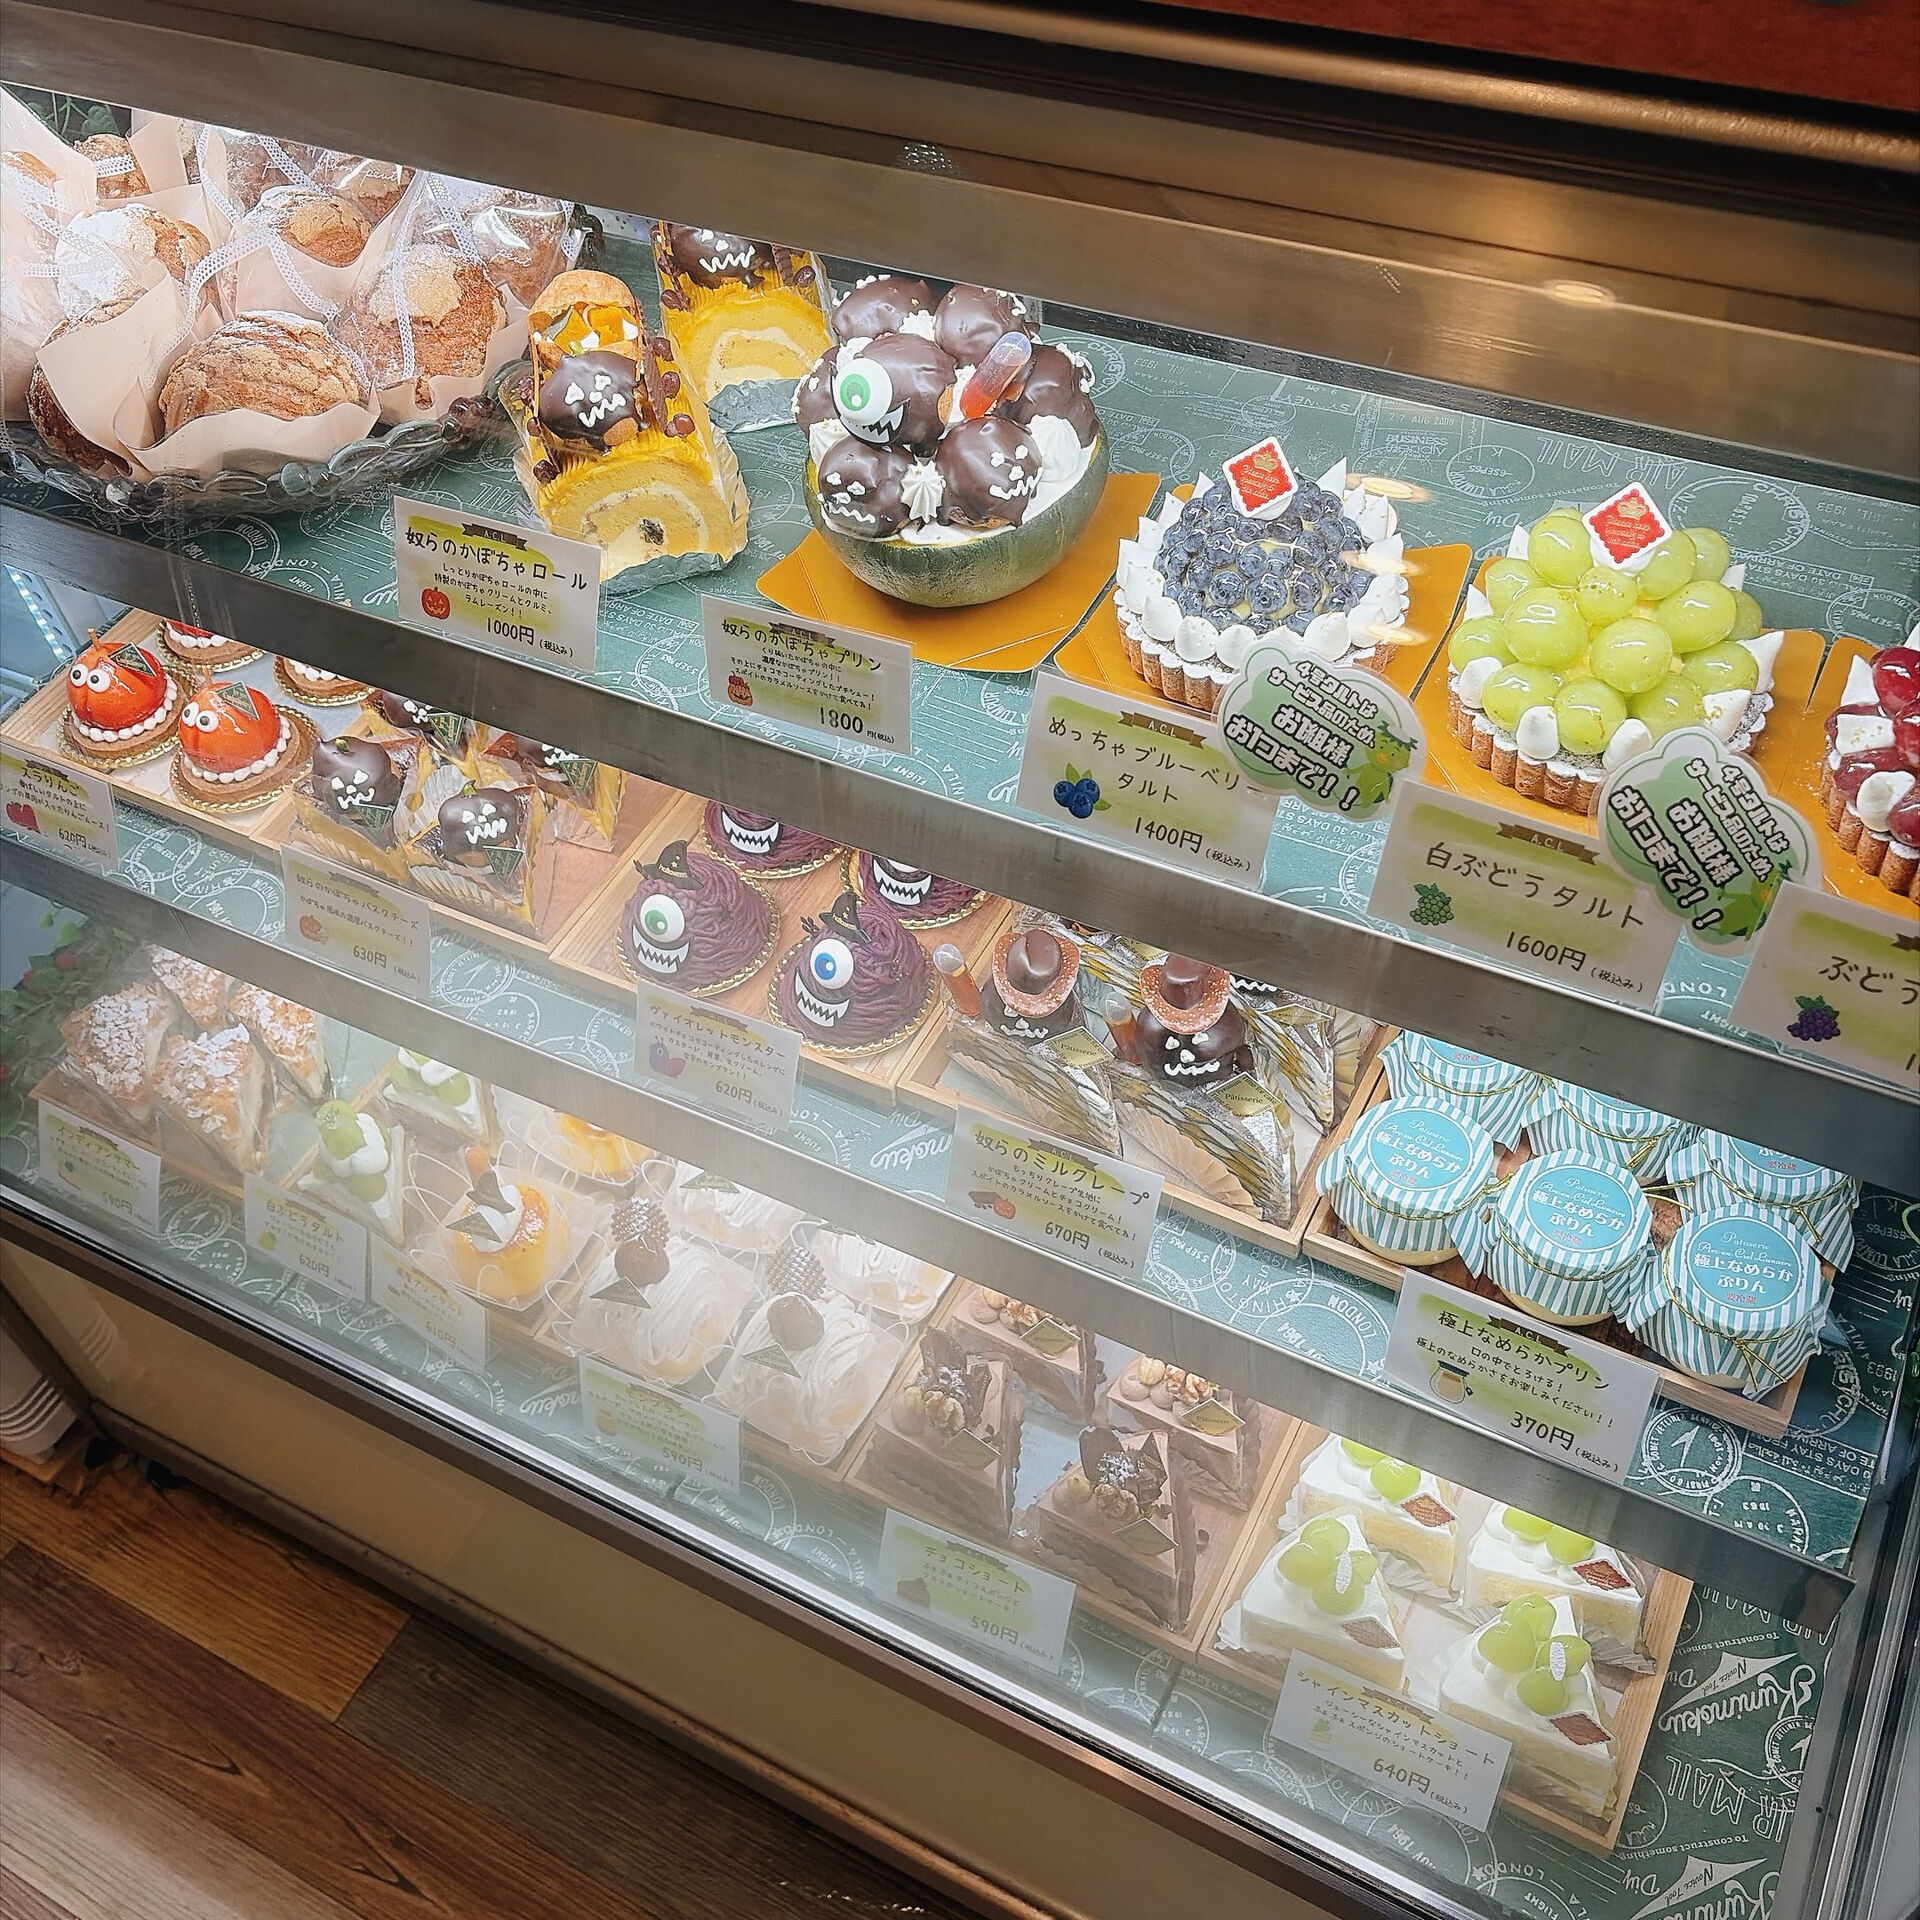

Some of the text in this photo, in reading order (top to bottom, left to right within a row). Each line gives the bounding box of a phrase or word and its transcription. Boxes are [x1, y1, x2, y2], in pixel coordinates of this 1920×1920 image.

[1537, 435, 1620, 476] MAIL
[405, 526, 587, 590] 奴らのかぼちゃロール
[486, 617, 534, 646] 1000円
[721, 619, 882, 671] 奴らのかぼちゃプリン
[1267, 666, 1377, 749] サービス品のため、
[1295, 660, 1378, 719] 4号タルトは
[820, 706, 864, 734] 1800
[1147, 720, 1177, 737] A.C.L
[1048, 716, 1262, 794] めっちゃブルーベリー
[1117, 772, 1178, 804] タルト
[1721, 765, 1790, 854] 4号タルトは
[1135, 816, 1251, 872] 1400円 (税込み)
[1425, 842, 1644, 929] 白ぶどうタルト
[353, 945, 387, 969] 630円
[1505, 931, 1643, 992] 1600円 (税込み)
[650, 1005, 786, 1058] ヴァイオレットモンスター
[715, 1080, 752, 1104] 620円
[974, 1130, 1150, 1205] 奴らのミルクレープ
[1045, 1221, 1090, 1250] 670円
[299, 1254, 329, 1278] 620円
[1437, 1310, 1610, 1390] 極上なめらかプリン
[1470, 1346, 1563, 1393] 口の中でとろける!
[663, 1447, 703, 1472] 590円
[1510, 1411, 1619, 1473] 370円 (税込み)
[1825, 1456, 1859, 1475] DAYS
[925, 1546, 1025, 1594] チョコショート
[970, 1615, 1019, 1645] 590円
[1296, 1670, 1495, 1765] シャインマスカットショート
[1373, 1758, 1431, 1794] 640円
[1666, 1755, 1746, 1825] MAIL
[1679, 1837, 1734, 1853] construct
